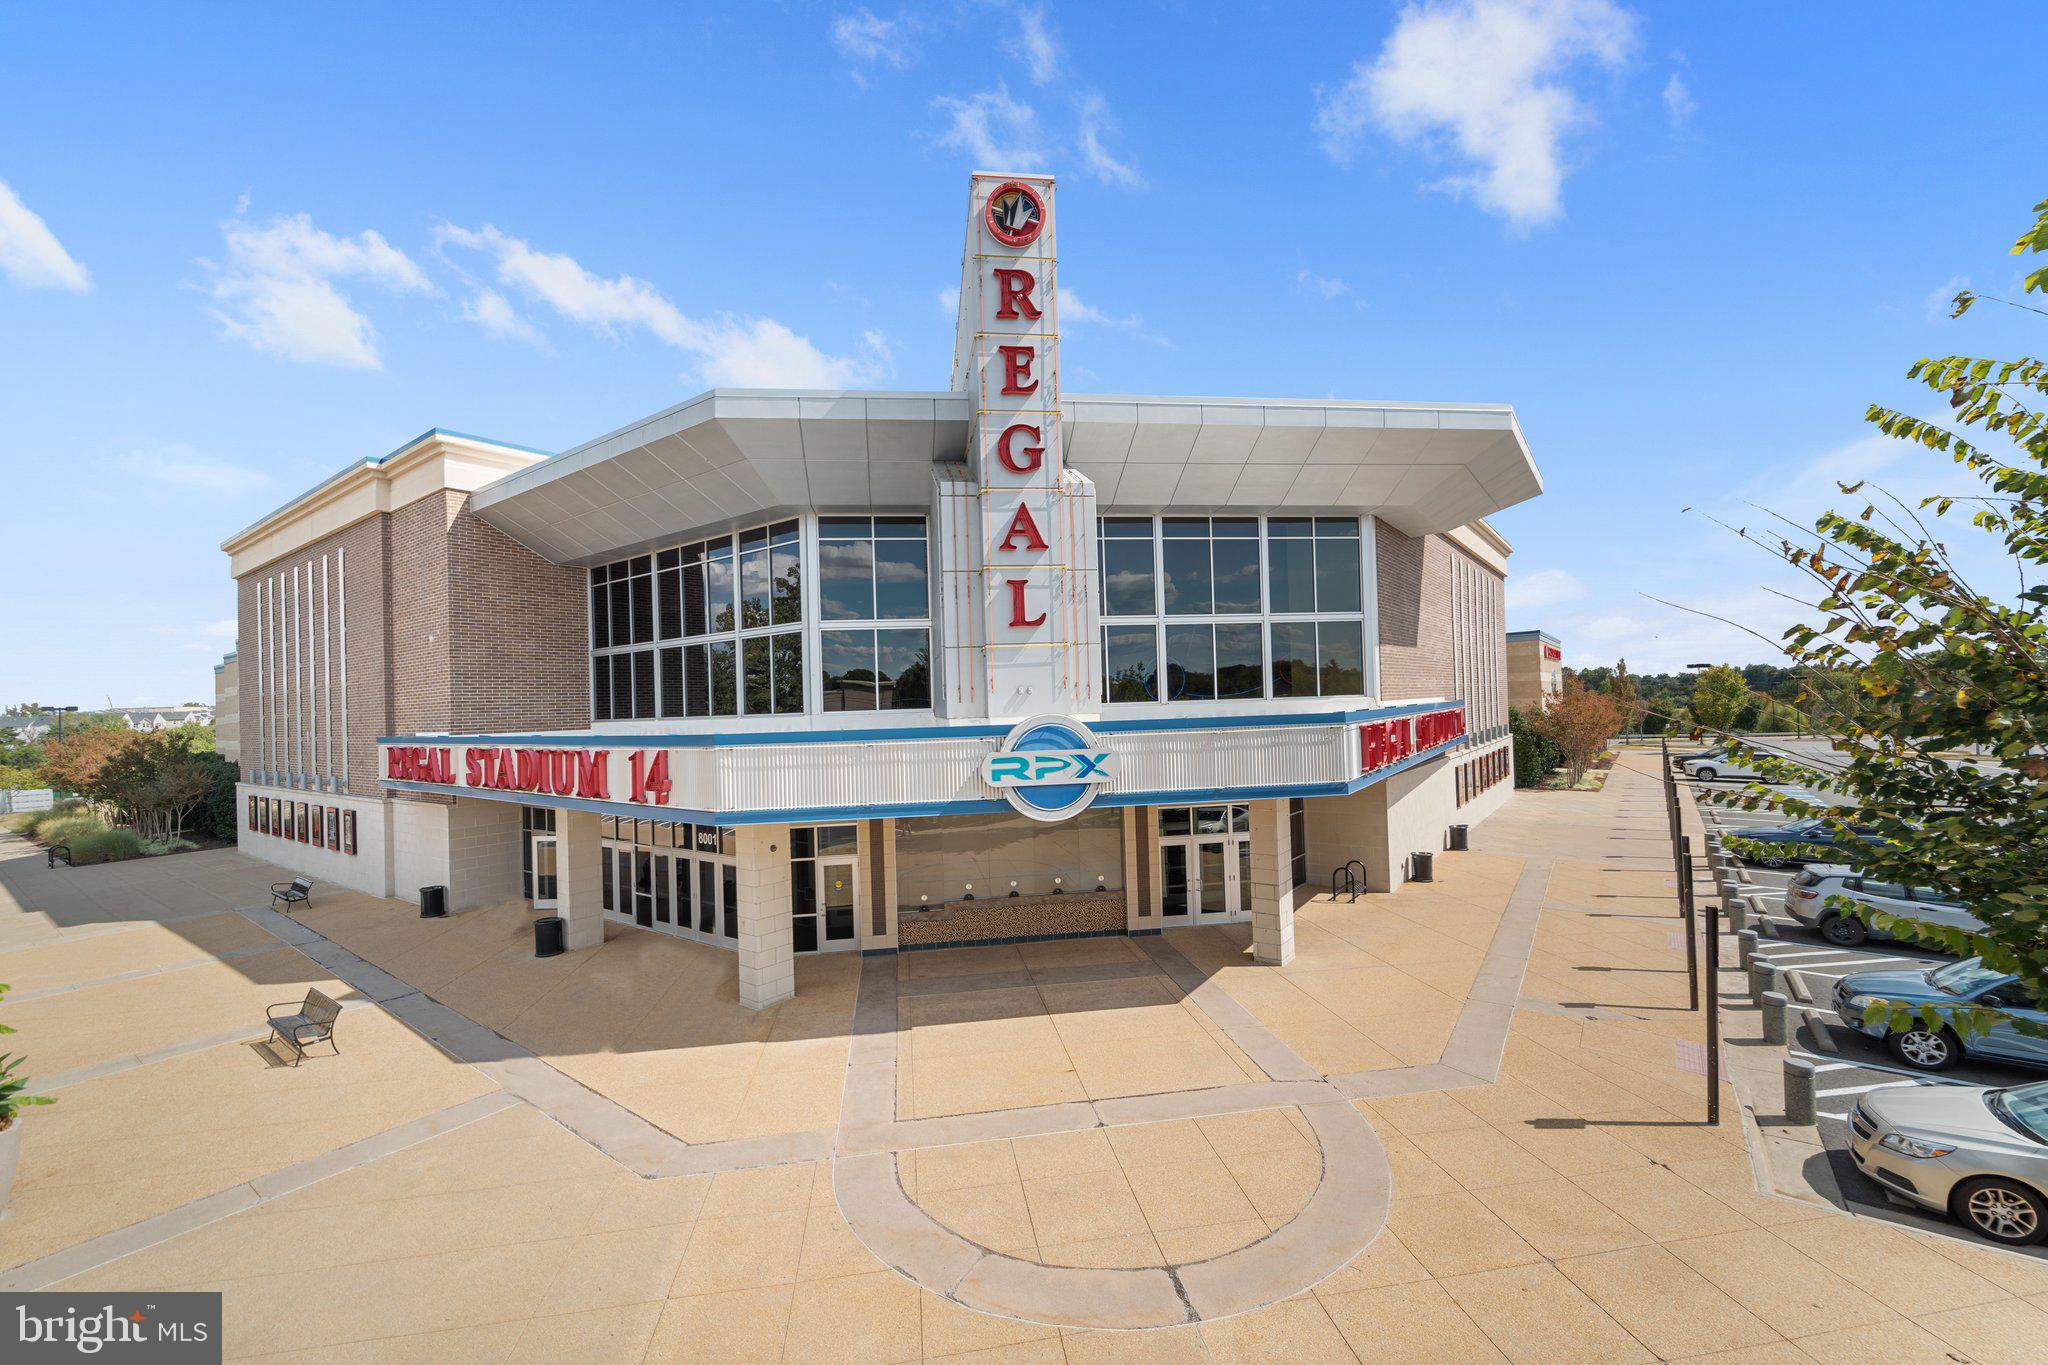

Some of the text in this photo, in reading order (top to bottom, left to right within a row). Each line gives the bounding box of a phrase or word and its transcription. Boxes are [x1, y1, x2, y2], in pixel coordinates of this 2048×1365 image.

[993, 268, 1049, 628] REGAL
[465, 747, 611, 800] STADIUM
[628, 750, 673, 806] 14
[991, 753, 1112, 782] RPX
[698, 832, 717, 846] 8001
